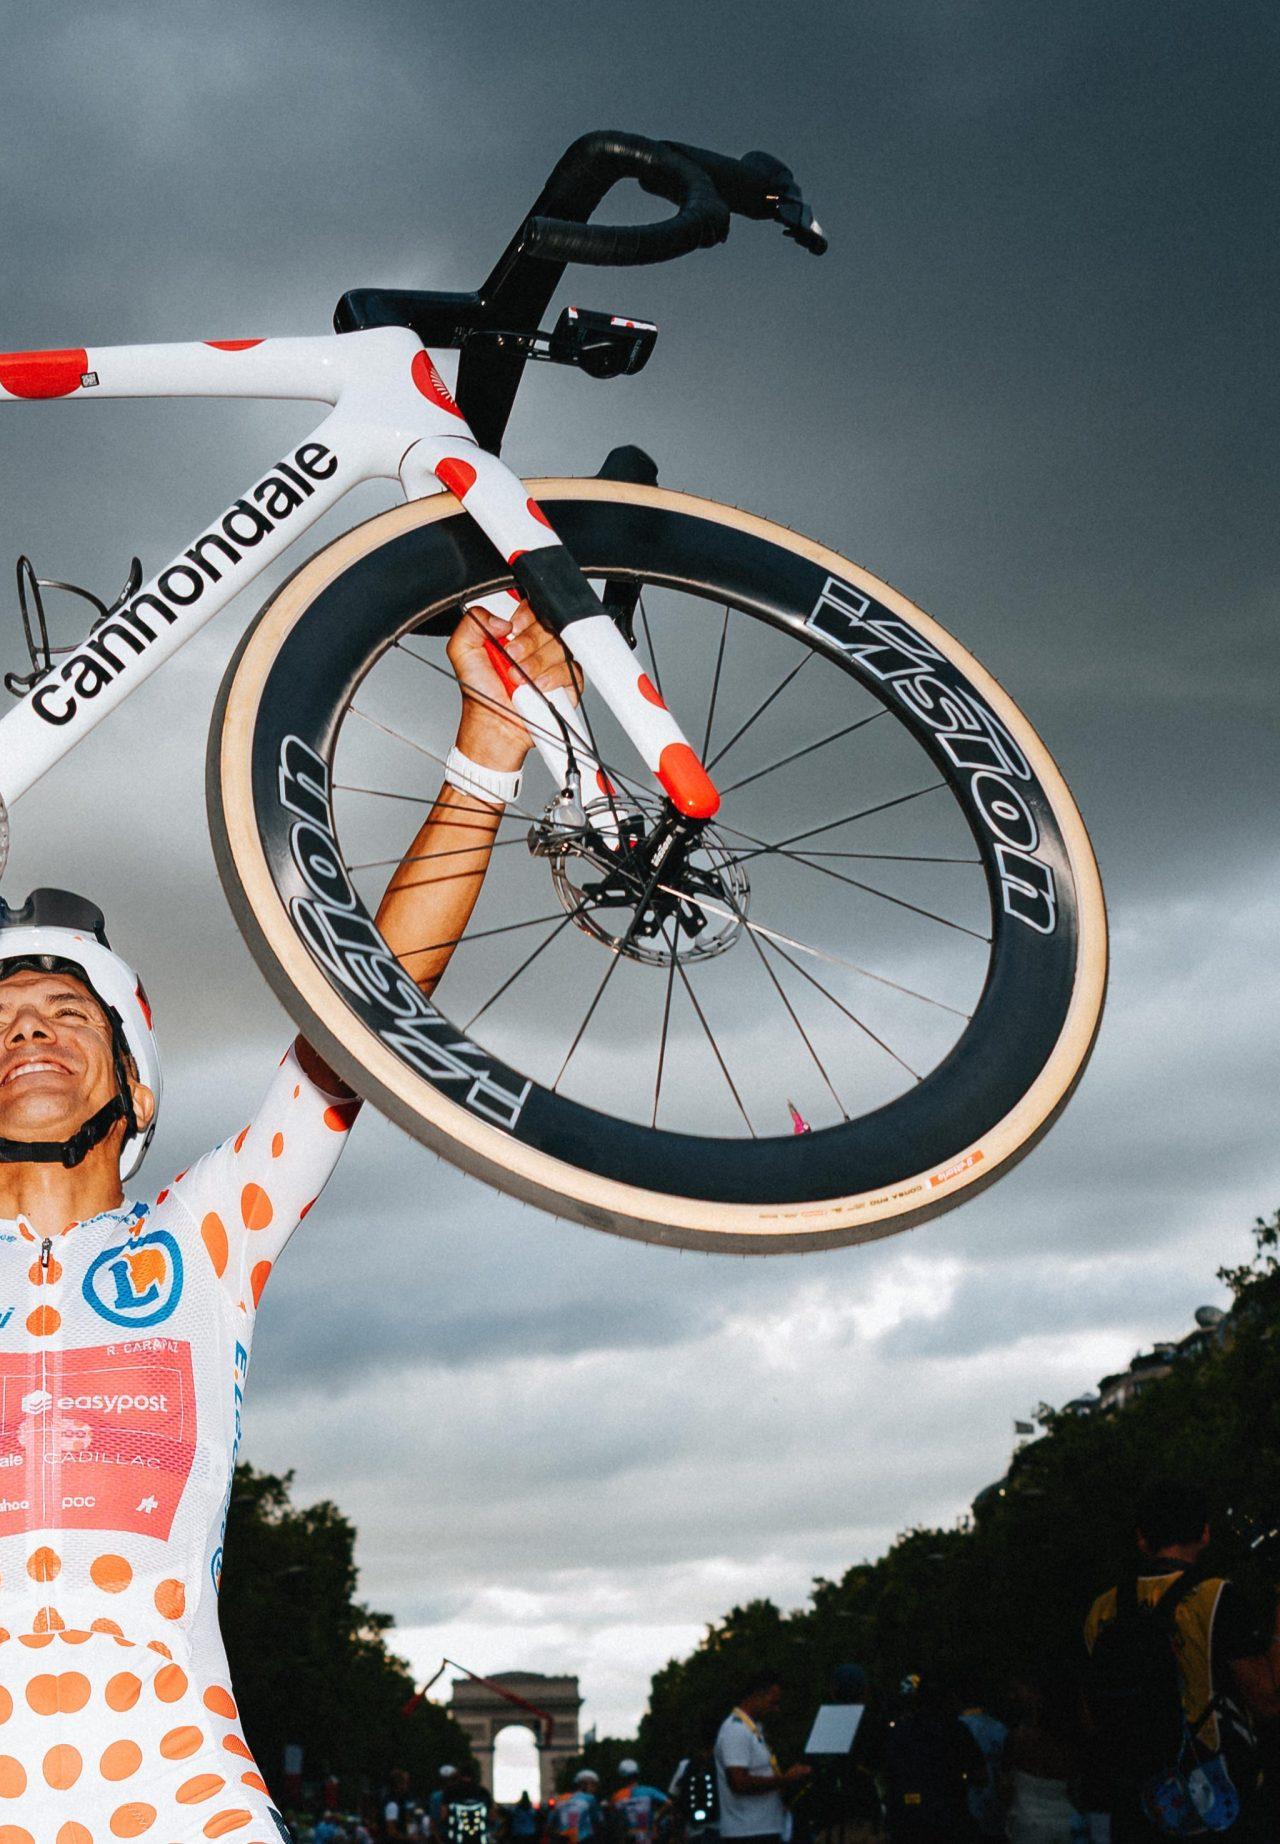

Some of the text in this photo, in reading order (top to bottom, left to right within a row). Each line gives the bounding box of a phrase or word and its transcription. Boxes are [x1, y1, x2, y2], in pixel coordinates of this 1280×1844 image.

[31, 442, 339, 727] cannondale
[57, 1393, 169, 1414] easypost
[43, 1451, 162, 1470] CADILLAC
[60, 1496, 96, 1510] poc
